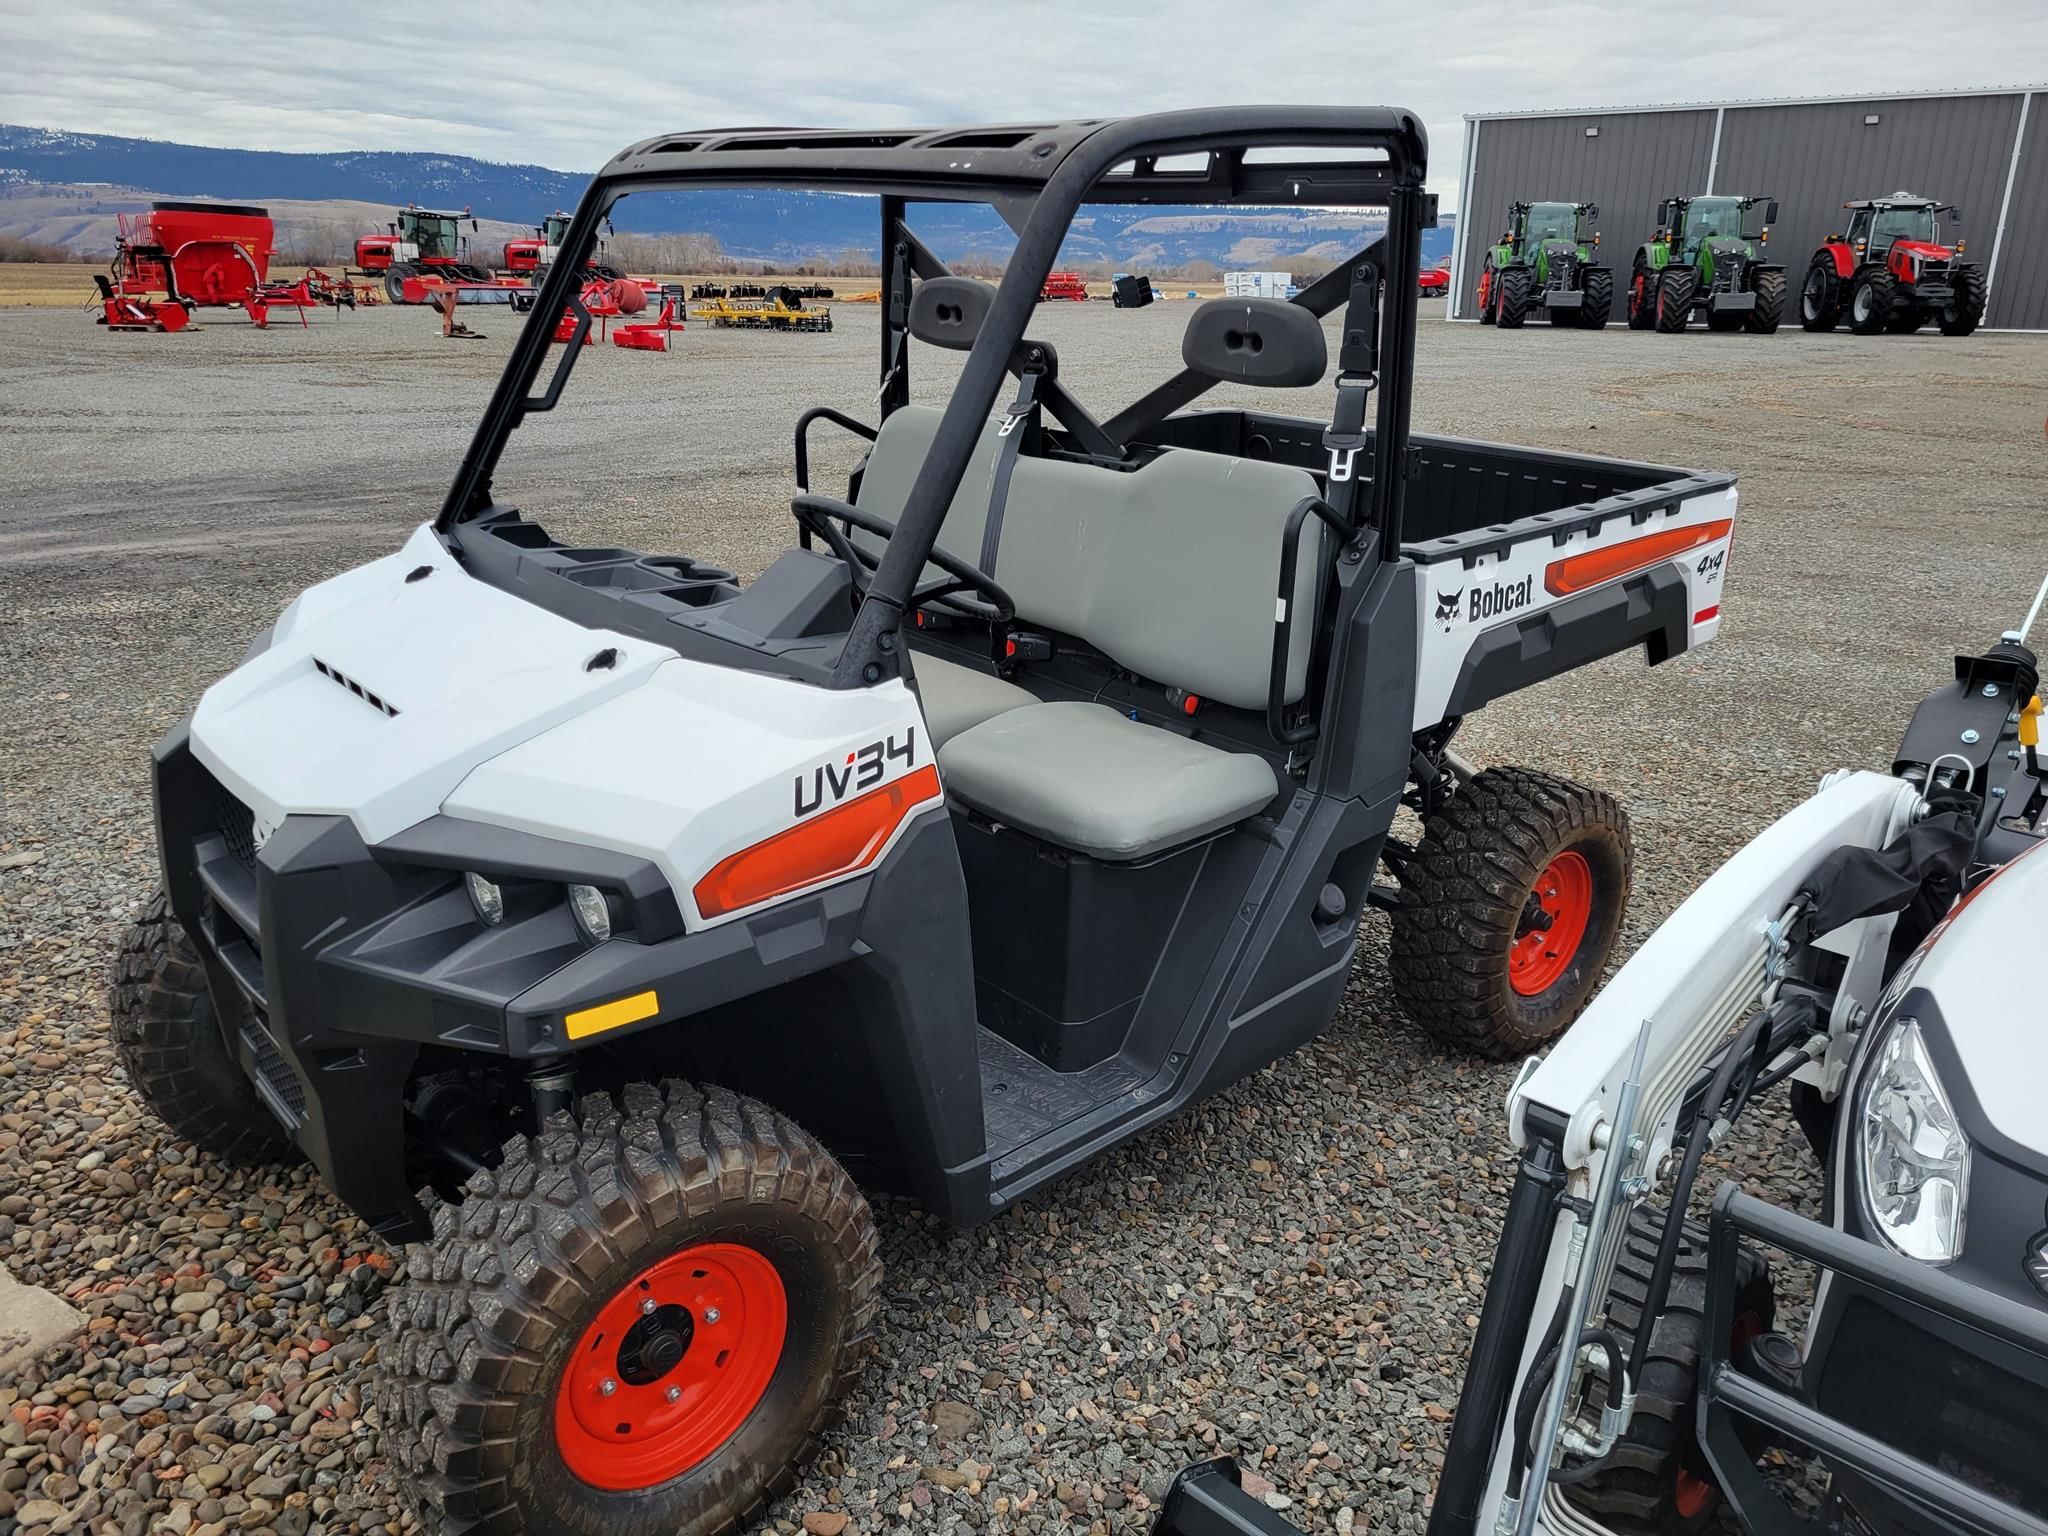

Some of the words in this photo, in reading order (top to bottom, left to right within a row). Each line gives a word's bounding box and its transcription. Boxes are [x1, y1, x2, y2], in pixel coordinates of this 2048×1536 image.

[1696, 550, 1726, 577] 4x4
[1469, 574, 1532, 623] Bobcat
[794, 726, 914, 818] UV34
